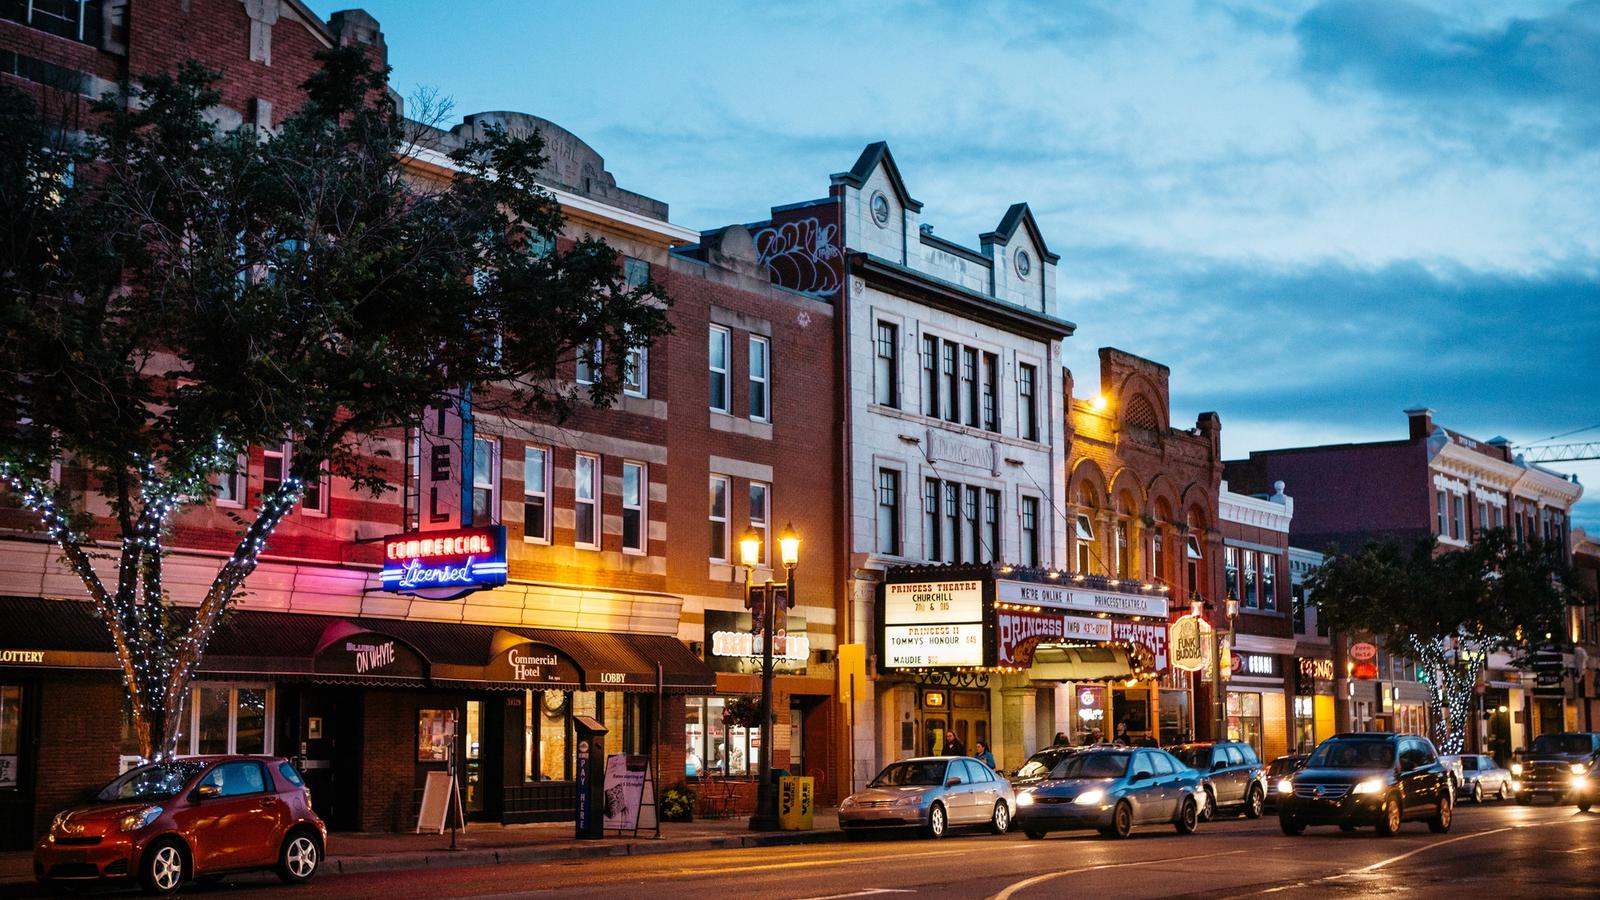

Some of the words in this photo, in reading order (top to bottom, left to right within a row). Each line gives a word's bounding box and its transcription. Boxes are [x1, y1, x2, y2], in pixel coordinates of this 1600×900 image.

[507, 127, 578, 166] OMMRCIAL
[430, 398, 453, 523] TEL
[387, 535, 491, 559] COMMERCIAL
[399, 555, 472, 587] Licensed
[891, 584, 933, 593] PRINCESS
[937, 582, 977, 591] THEATRE
[1020, 587, 1039, 600] WE'RE
[1042, 589, 1062, 602] ONLINE
[1066, 592, 1074, 604] AT
[912, 593, 953, 602] CHURCHILL
[908, 627, 950, 635] PRINCESS
[952, 626, 960, 634] II
[999, 614, 1063, 664] PRINCESS
[891, 637, 924, 645] TOMMYS
[929, 636, 960, 645] HONOUR
[1113, 623, 1168, 671] THEATRE
[1178, 638, 1196, 649] FUNK
[356, 651, 369, 673] ON
[369, 641, 395, 669] WHYTE
[508, 649, 558, 667] Commercial
[893, 656, 922, 665] MAUDIE
[514, 665, 540, 680] Hotel
[601, 673, 626, 683] LOBBY
[783, 781, 791, 816] VUE
